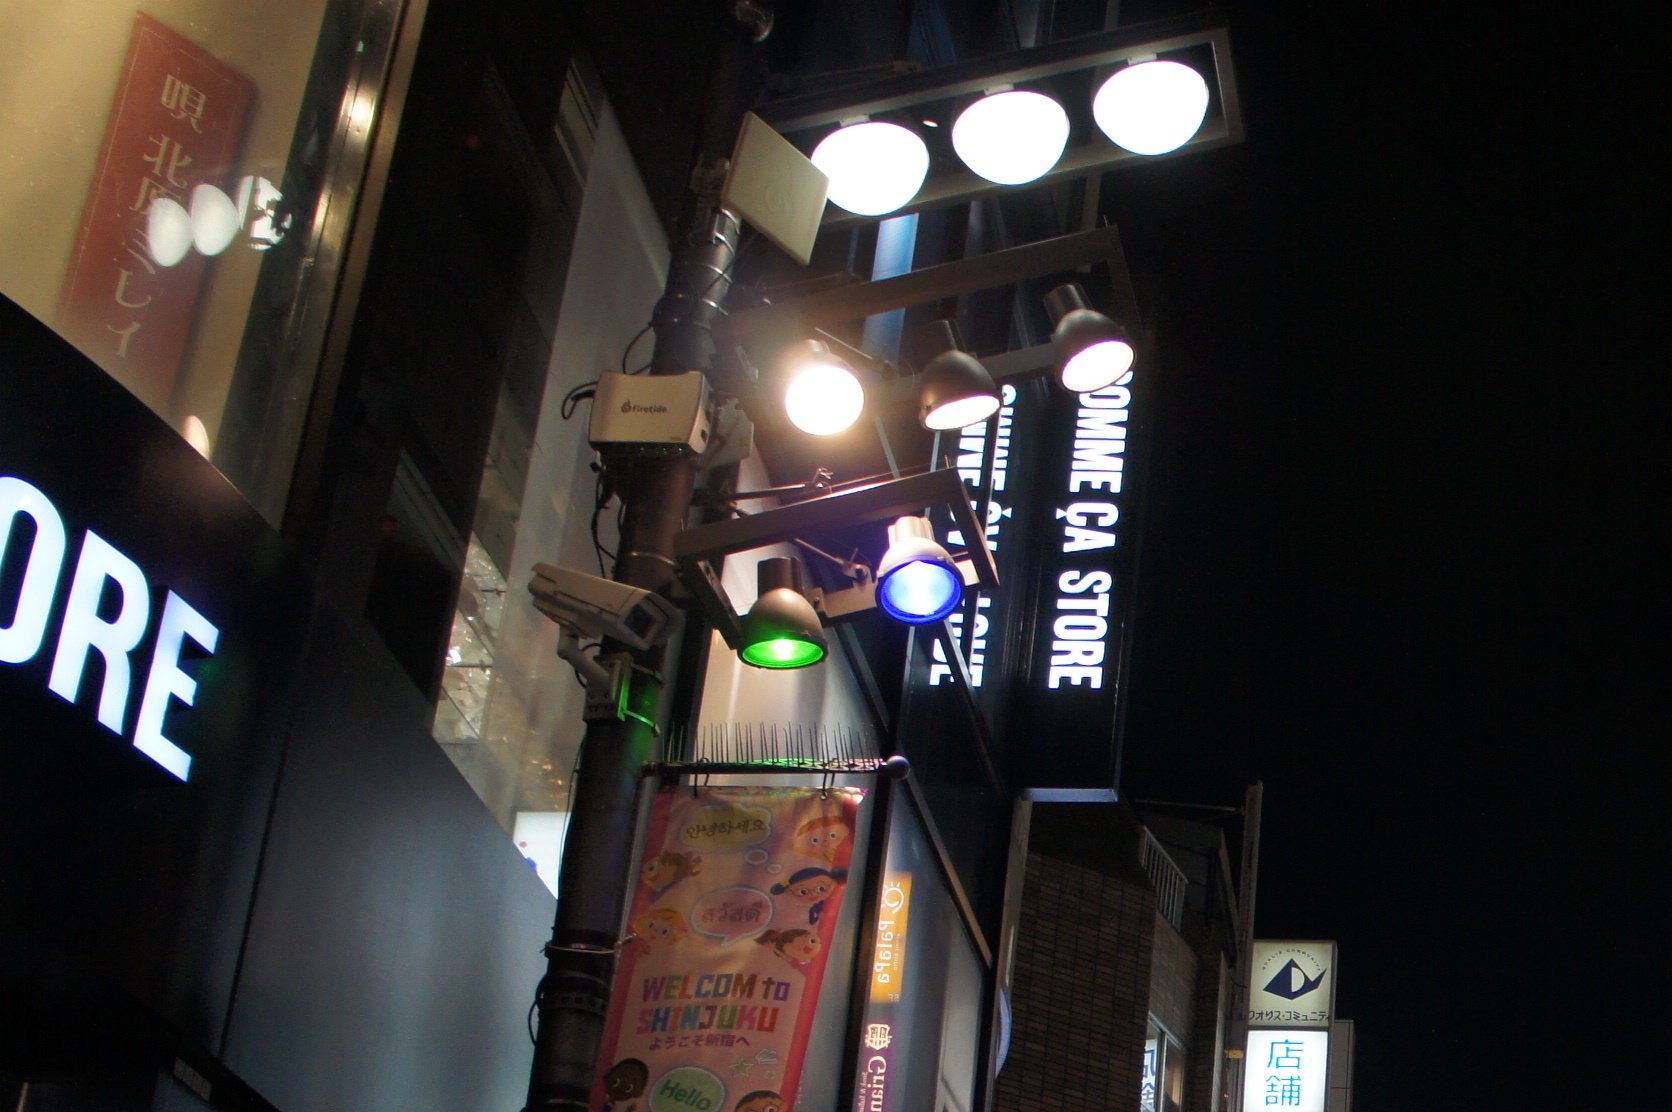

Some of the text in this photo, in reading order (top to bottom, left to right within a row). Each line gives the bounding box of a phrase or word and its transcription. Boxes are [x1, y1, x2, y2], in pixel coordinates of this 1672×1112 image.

[632, 402, 668, 415] firetide
[1069, 372, 1133, 495] OMME
[1048, 569, 1113, 692] STORE
[686, 815, 766, 838] 안녕하세요
[641, 973, 791, 1002] WELCOM to
[636, 1005, 779, 1034] SHINJUKU
[648, 1031, 751, 1049] ようこそ新宿へ
[1265, 1038, 1305, 1107] 店舗
